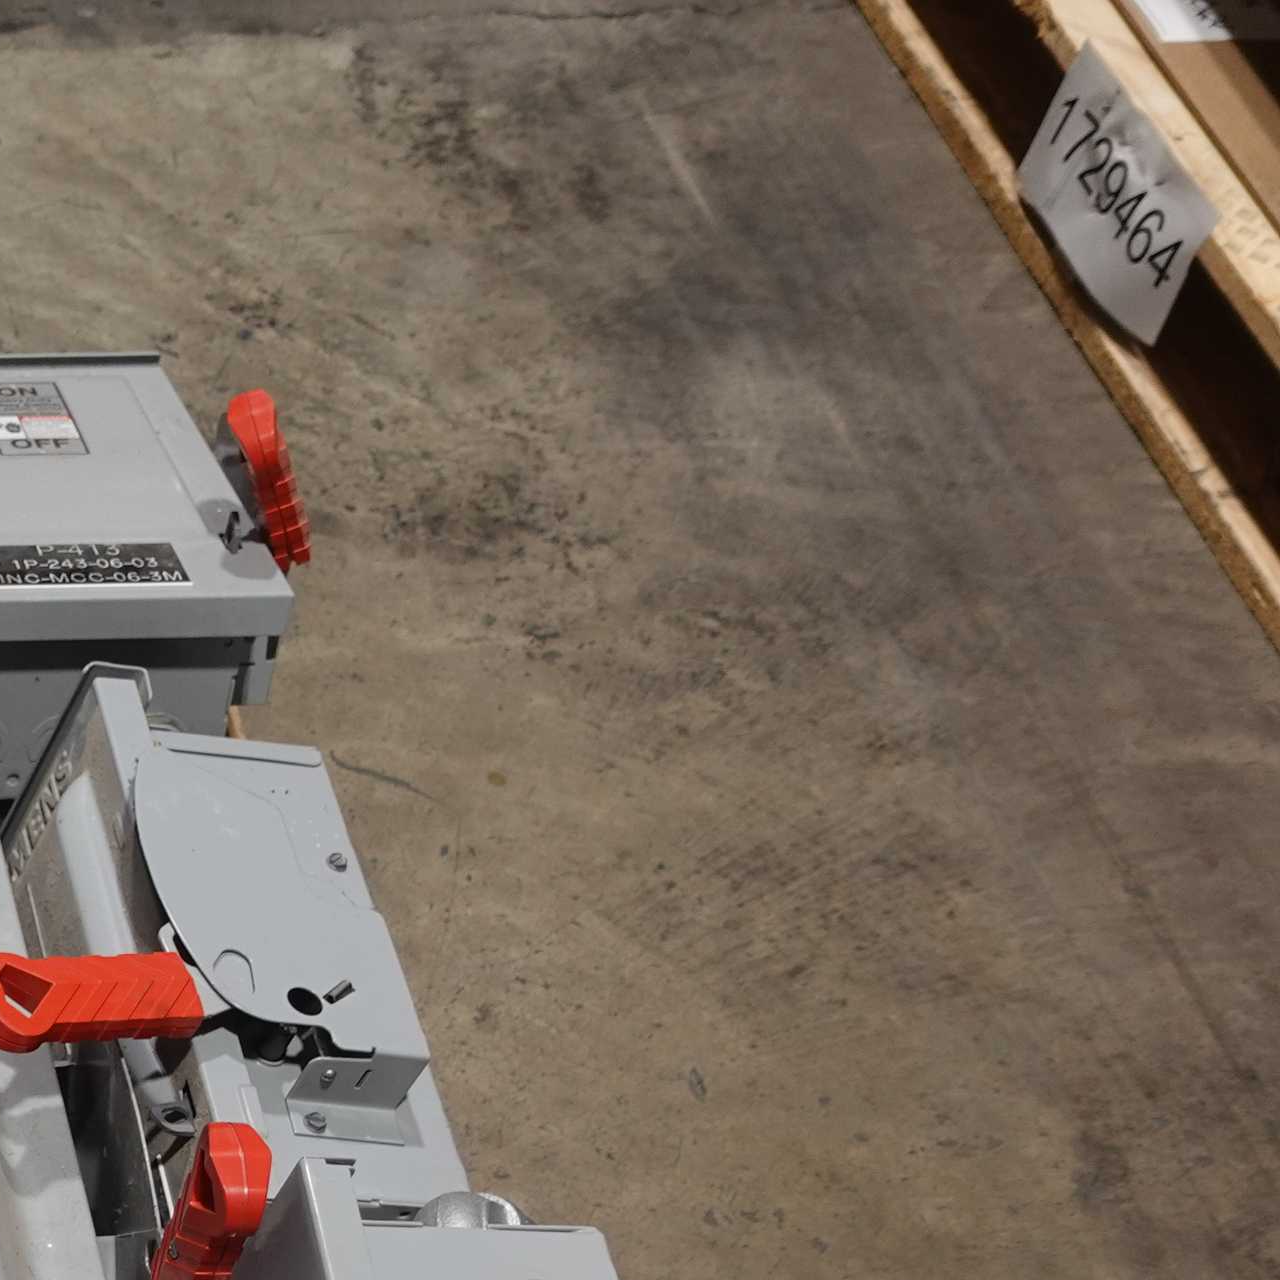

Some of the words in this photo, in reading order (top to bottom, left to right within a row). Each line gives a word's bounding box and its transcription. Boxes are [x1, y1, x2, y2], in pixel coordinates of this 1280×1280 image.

[1050, 97, 1183, 289] 1729464
[11, 438, 69, 449] OFF
[35, 544, 120, 556] P-413
[12, 557, 158, 570] 1P-243-06-03
[0, 571, 183, 584] INC-MCC-06-3M
